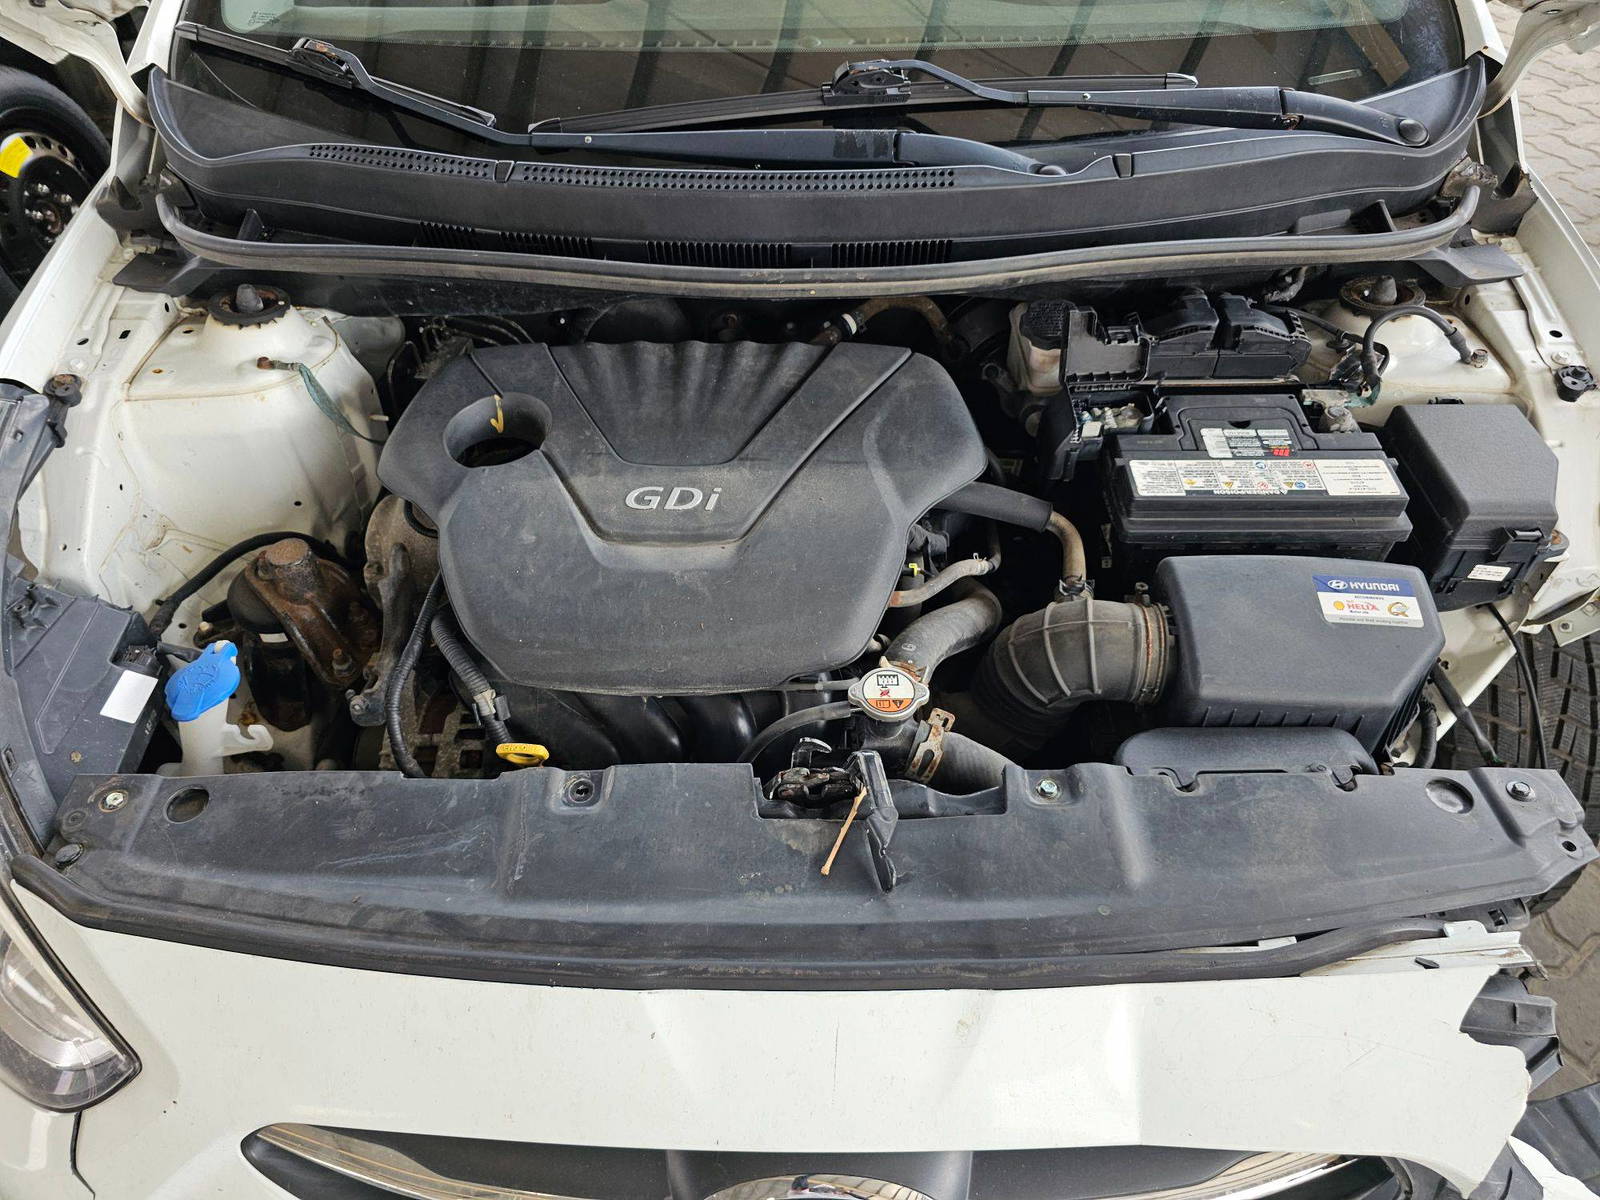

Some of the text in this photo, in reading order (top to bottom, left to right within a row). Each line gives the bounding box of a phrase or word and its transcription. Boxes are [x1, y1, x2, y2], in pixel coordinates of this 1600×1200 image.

[625, 486, 722, 510] GDi
[1350, 581, 1400, 592] HYUNDAI
[1347, 603, 1379, 611] HELIX
